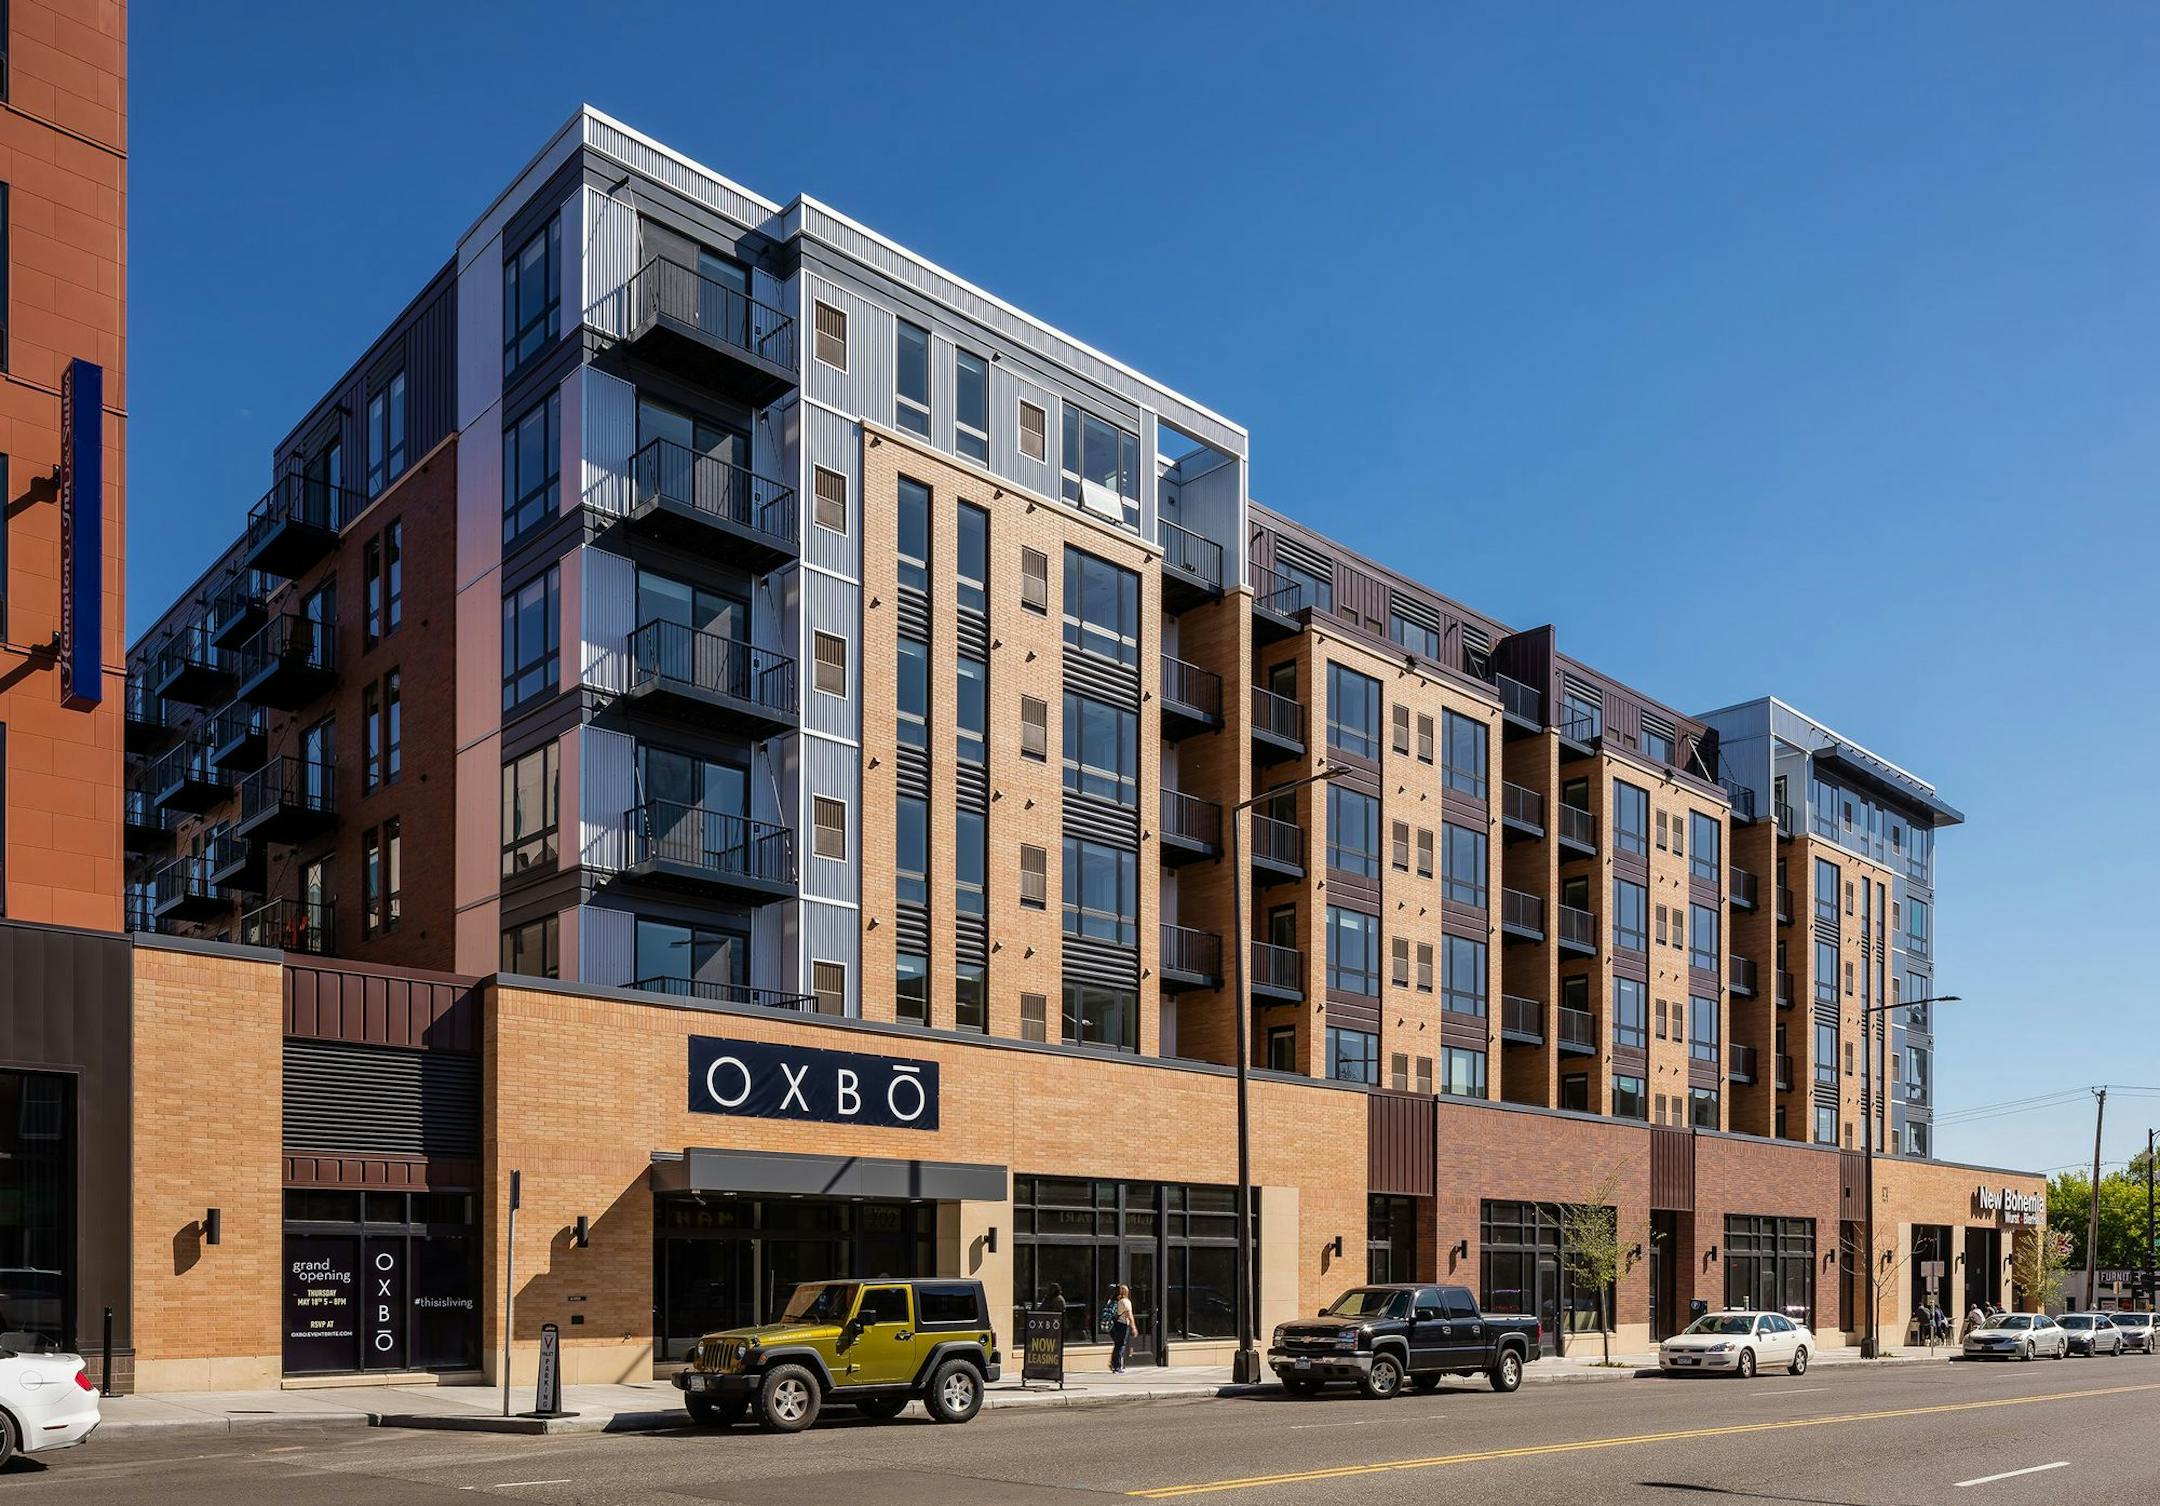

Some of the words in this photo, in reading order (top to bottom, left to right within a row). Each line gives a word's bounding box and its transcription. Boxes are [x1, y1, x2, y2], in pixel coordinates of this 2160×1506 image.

[63, 371, 72, 449] Suites
[62, 468, 72, 541] Inn
[62, 544, 72, 689] Hampton
[1980, 1185, 2002, 1210] New
[2004, 1188, 2044, 1212] Bohemia
[292, 1258, 330, 1273] grand
[299, 1270, 351, 1283] opening
[307, 1289, 337, 1297] THURSDAY
[323, 1298, 329, 1306] 5
[414, 1296, 473, 1309] #thisisliving
[310, 1320, 326, 1329] RSVP
[326, 1320, 334, 1328] AT
[1031, 1337, 1056, 1352] NOW
[1027, 1353, 1059, 1365] LEASING
